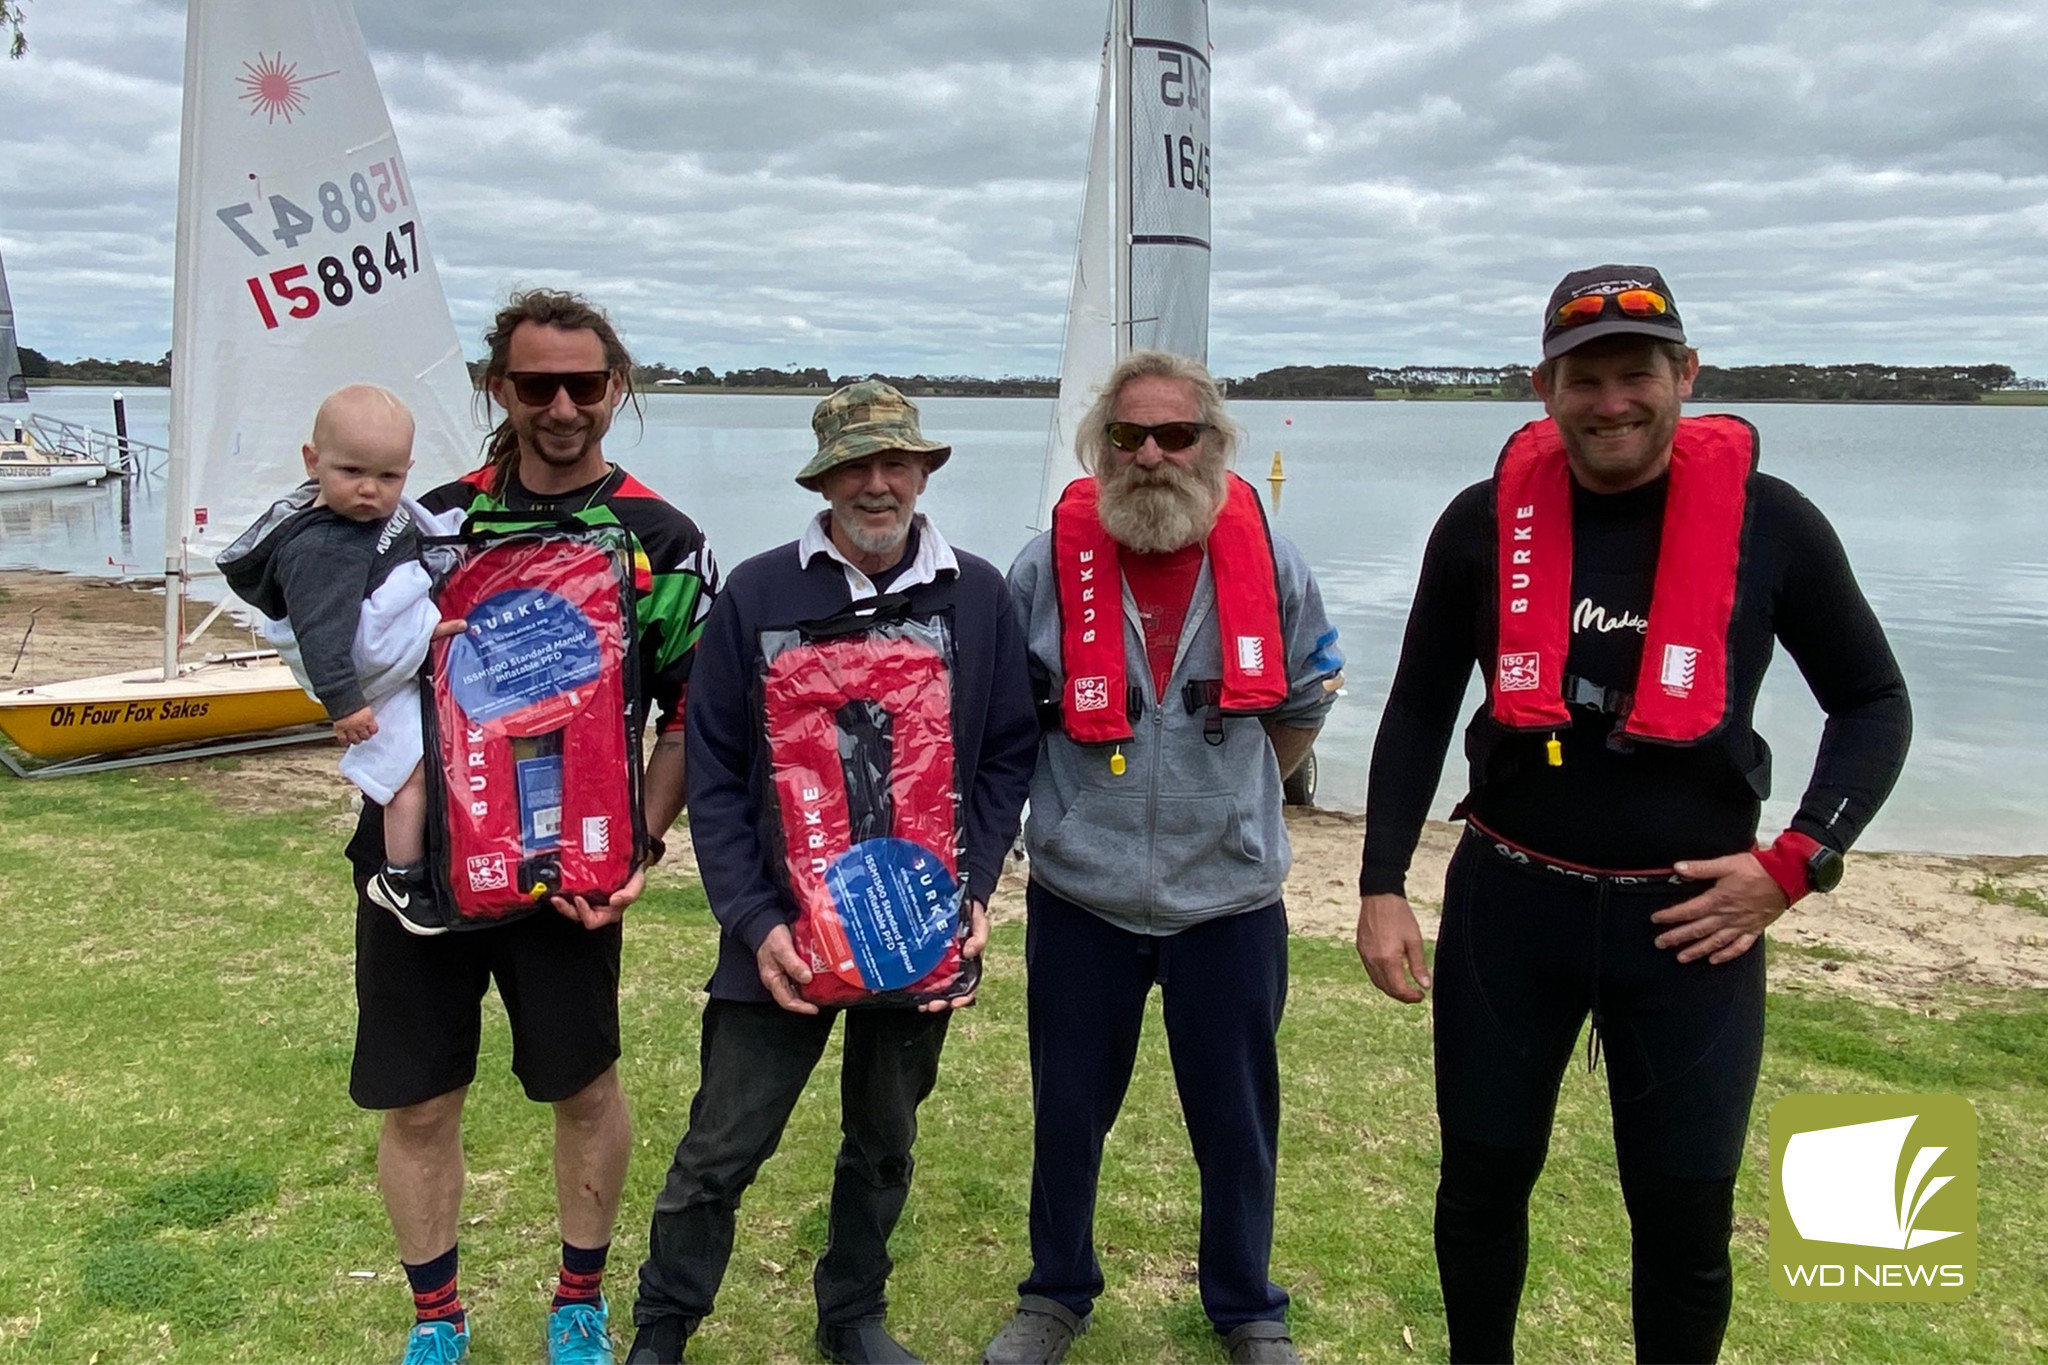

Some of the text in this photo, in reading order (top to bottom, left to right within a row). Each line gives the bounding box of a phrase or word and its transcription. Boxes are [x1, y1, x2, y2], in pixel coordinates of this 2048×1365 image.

[246, 220, 419, 330] 158847
[1511, 504, 1534, 614] BURKE
[471, 598, 547, 635] BURKE
[1079, 549, 1096, 643] BURKE
[463, 661, 509, 685] ISSM1500
[510, 644, 553, 666] Standard
[554, 631, 588, 651] Manual
[495, 660, 540, 684] Inflatable
[540, 651, 563, 666] PFD
[1077, 680, 1095, 690] 150
[1503, 656, 1523, 666] 150
[50, 700, 210, 727] Oh Four Fox Sakes
[467, 728, 488, 816] BURK
[803, 786, 828, 874] URKE
[470, 857, 490, 869] 150
[914, 858, 949, 931] BURKE
[864, 854, 888, 899] ISSM1500
[882, 898, 903, 941] Standard
[897, 939, 917, 974] Manual
[866, 887, 886, 929] Inflatable
[881, 928, 896, 951] PFD
